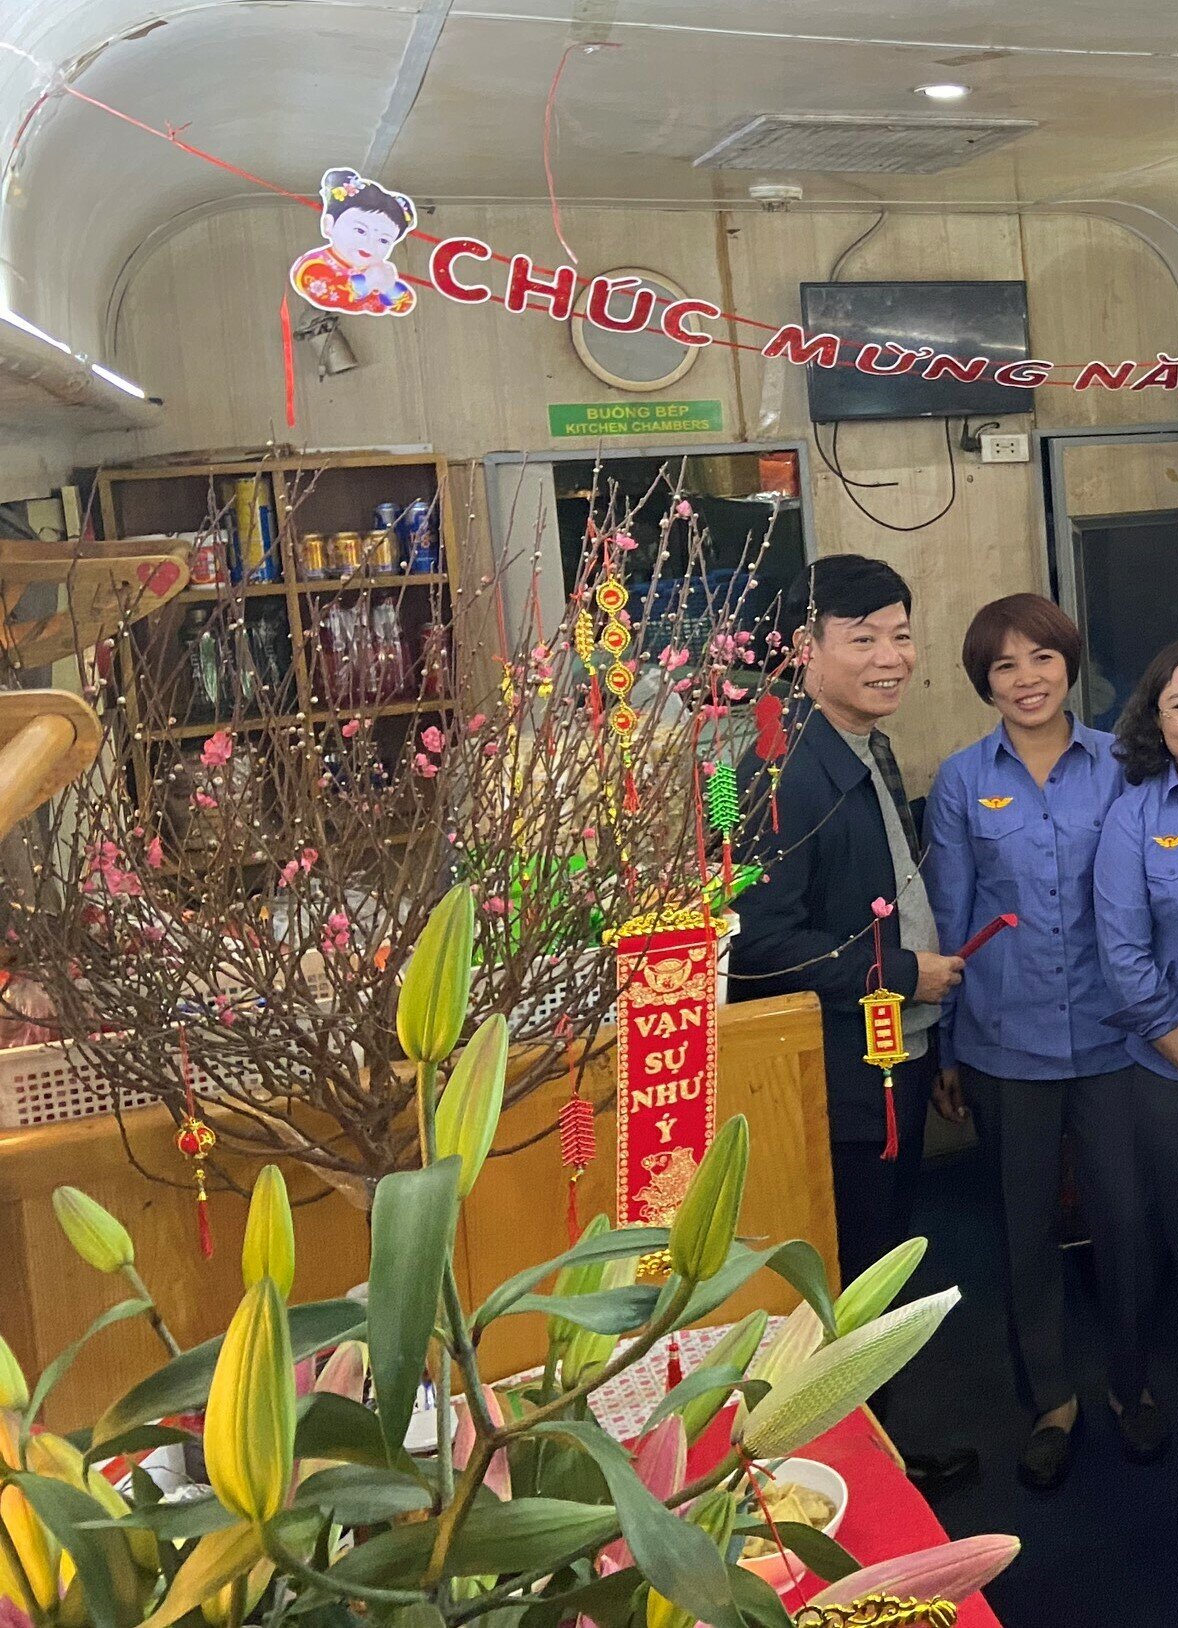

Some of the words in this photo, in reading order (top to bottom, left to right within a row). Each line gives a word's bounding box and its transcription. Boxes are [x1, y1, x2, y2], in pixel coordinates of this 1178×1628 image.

[429, 236, 721, 347] CHÚC
[761, 324, 1054, 388] MỪNG
[566, 422, 627, 434] KITCHEN
[632, 420, 709, 431] CHAMBERS
[633, 1005, 702, 1038] VẠN
[645, 1041, 689, 1075] SỰ
[630, 1071, 705, 1114] NHƯ
[655, 1112, 677, 1144] Ý
